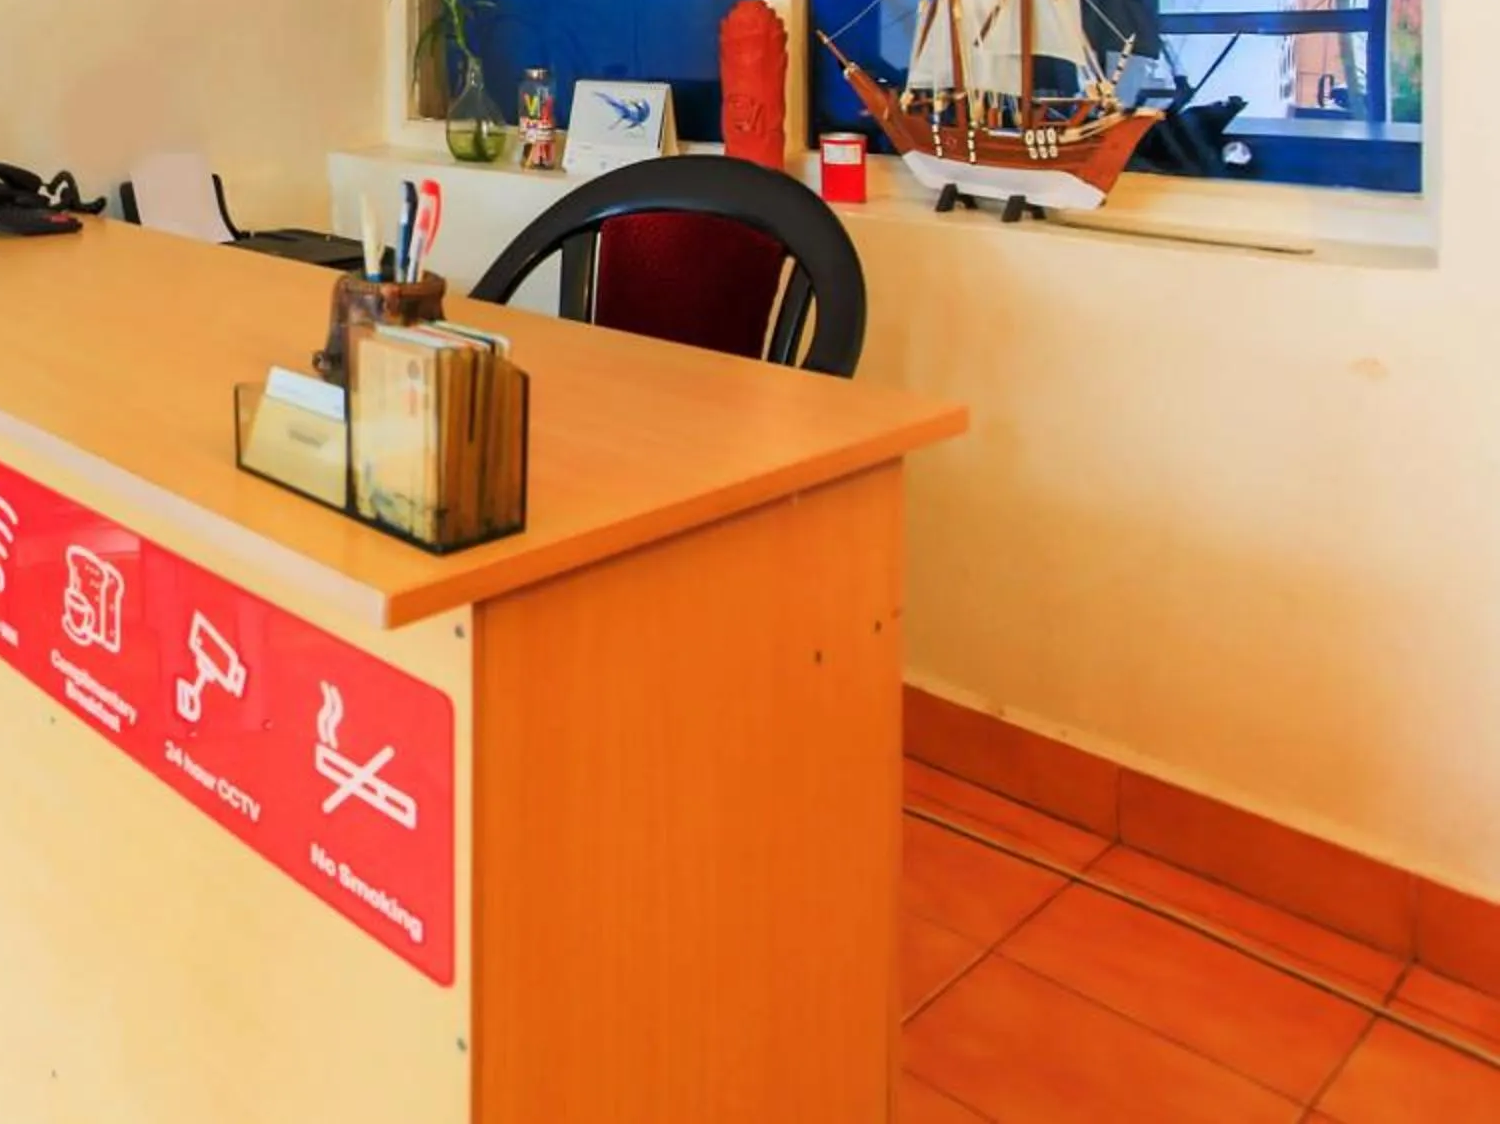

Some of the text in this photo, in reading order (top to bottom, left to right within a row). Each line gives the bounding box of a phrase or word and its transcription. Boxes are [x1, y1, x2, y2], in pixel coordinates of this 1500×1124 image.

[164, 739, 261, 823] 24 hour CCTV
[310, 842, 424, 944] No Smoking
